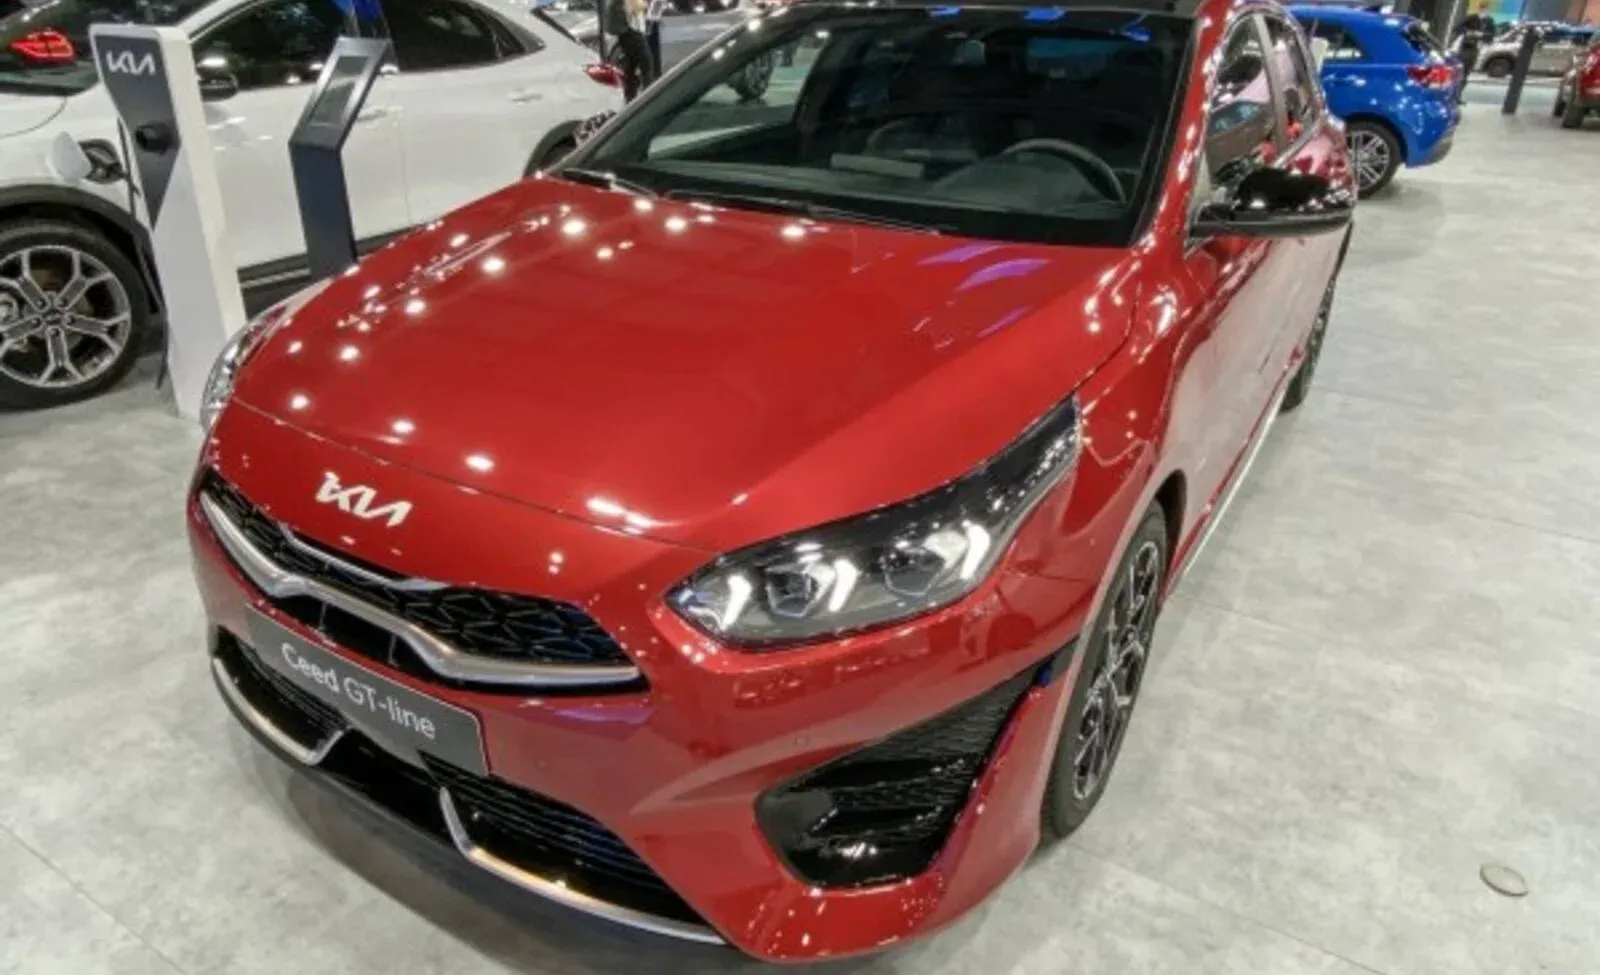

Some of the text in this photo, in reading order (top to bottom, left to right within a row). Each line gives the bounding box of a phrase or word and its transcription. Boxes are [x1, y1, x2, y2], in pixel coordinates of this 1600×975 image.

[315, 470, 412, 528] KIA
[281, 642, 436, 740] Ceed GT-line
